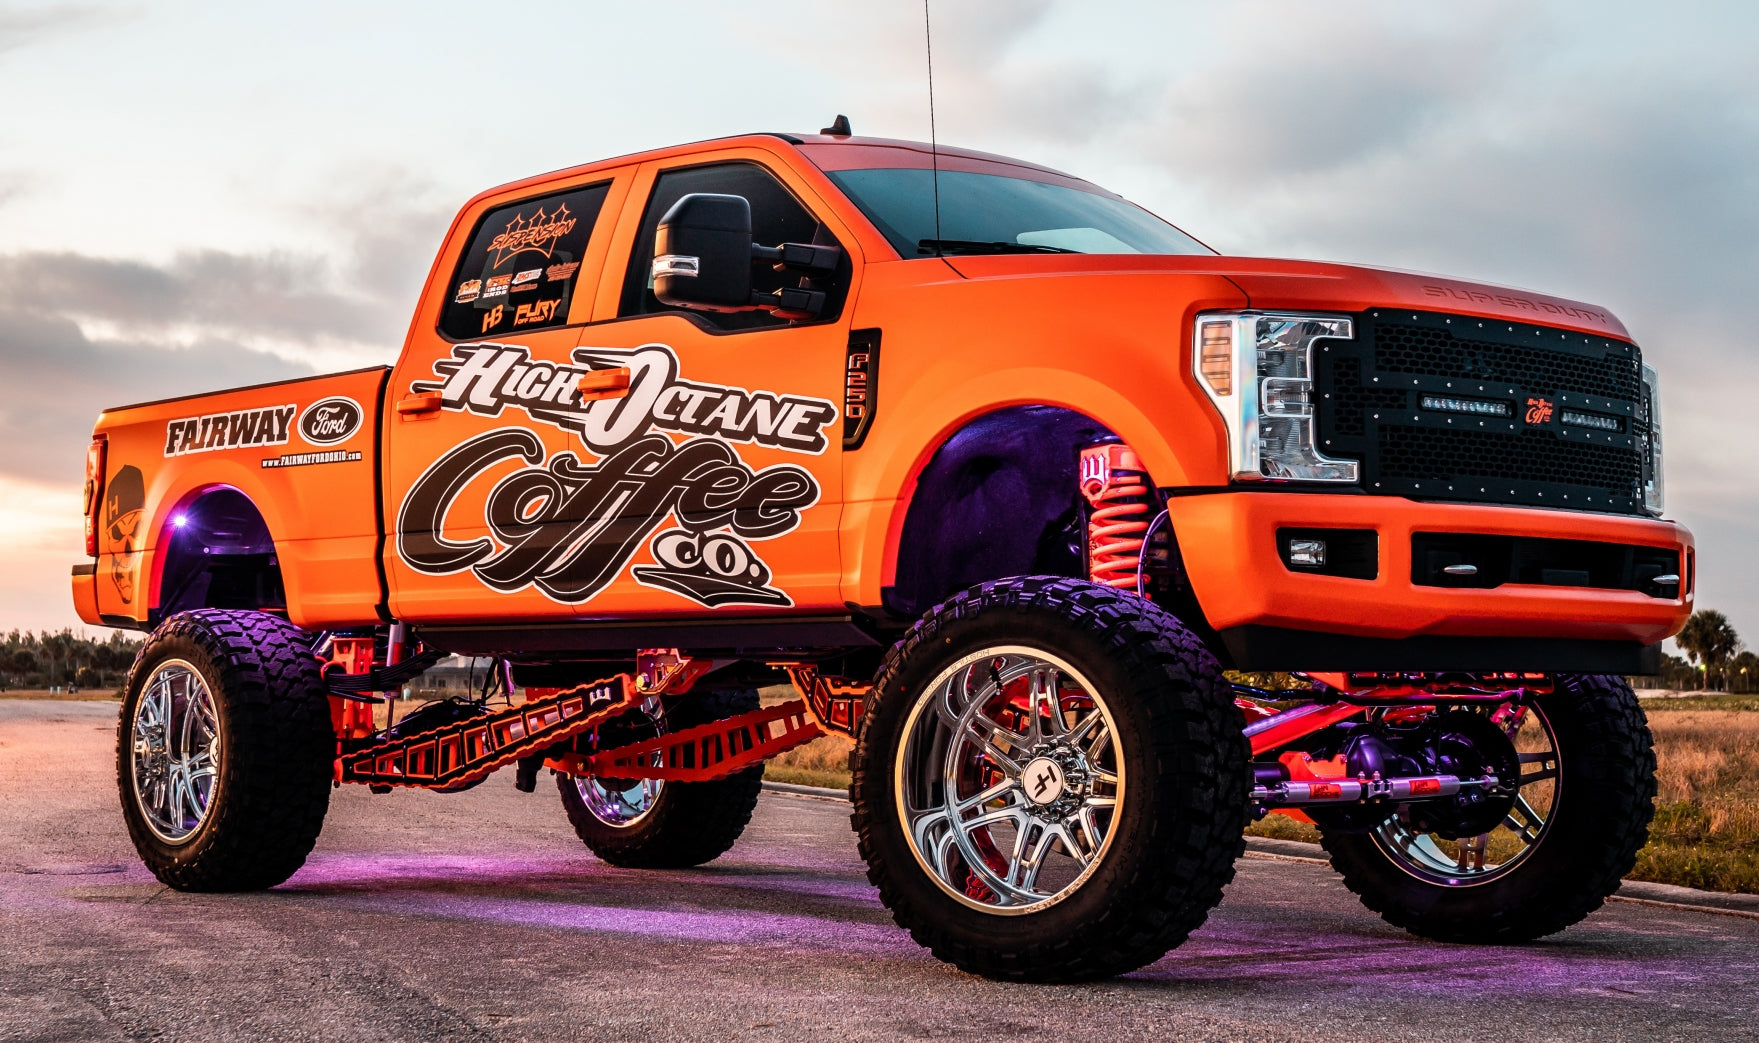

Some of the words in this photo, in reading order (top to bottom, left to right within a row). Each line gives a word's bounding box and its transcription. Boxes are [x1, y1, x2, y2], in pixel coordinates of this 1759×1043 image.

[486, 217, 577, 252] SUSPENSION
[513, 298, 562, 327] FURY
[517, 317, 529, 325] OFF
[528, 315, 545, 323] ROAD
[1422, 285, 1538, 311] SUPER
[1540, 301, 1606, 324] DUTY
[425, 343, 588, 414] HIGH
[580, 346, 834, 449] OCTANE
[846, 353, 870, 418] F250
[164, 404, 297, 457] FAIRWAY
[311, 406, 348, 436] Ford
[398, 428, 820, 603] Coffee
